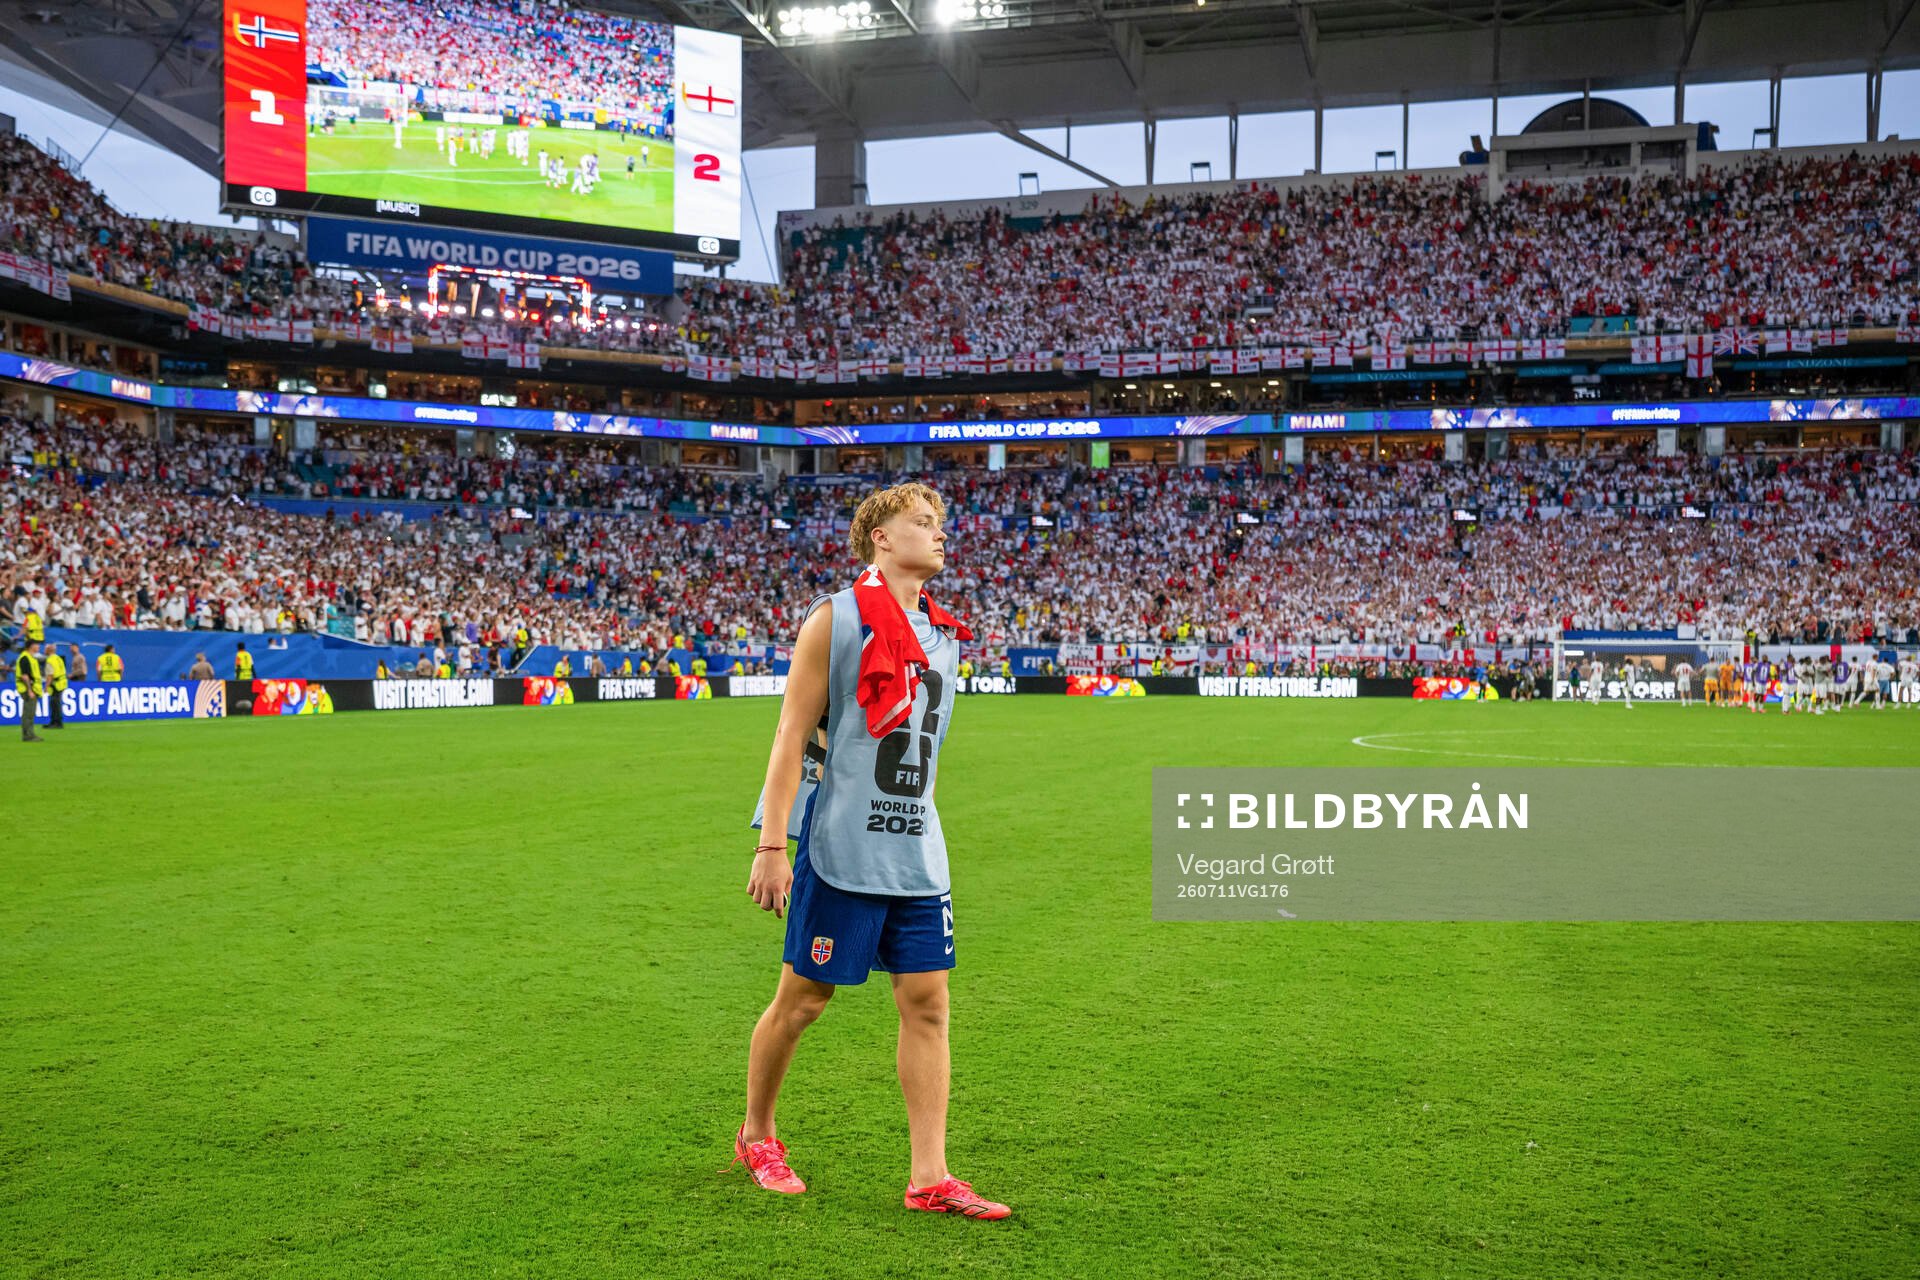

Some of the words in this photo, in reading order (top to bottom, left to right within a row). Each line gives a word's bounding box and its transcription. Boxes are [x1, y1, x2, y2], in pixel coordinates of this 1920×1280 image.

[251, 89, 284, 126] 1
[693, 153, 720, 182] 2
[254, 190, 273, 203] CC
[701, 240, 717, 251] CC
[346, 232, 404, 258] FIFA
[407, 238, 500, 266] WORLD
[502, 248, 553, 271] CUP
[556, 253, 641, 281] 2026
[111, 378, 151, 401] MIAMI
[710, 424, 759, 440] MIAMI
[929, 425, 962, 439] FIFA
[962, 423, 1016, 438] WORLD
[1016, 422, 1047, 437] CUP
[1290, 414, 1345, 430] MIAMI
[598, 679, 624, 699] FIFA
[1198, 676, 1239, 697] VISIT
[1239, 676, 1358, 698] FIFASTORE.COM
[79, 687, 106, 717] OF
[107, 686, 191, 715] AMERICA
[870, 799, 919, 816] WORLD
[866, 814, 925, 837] 202
